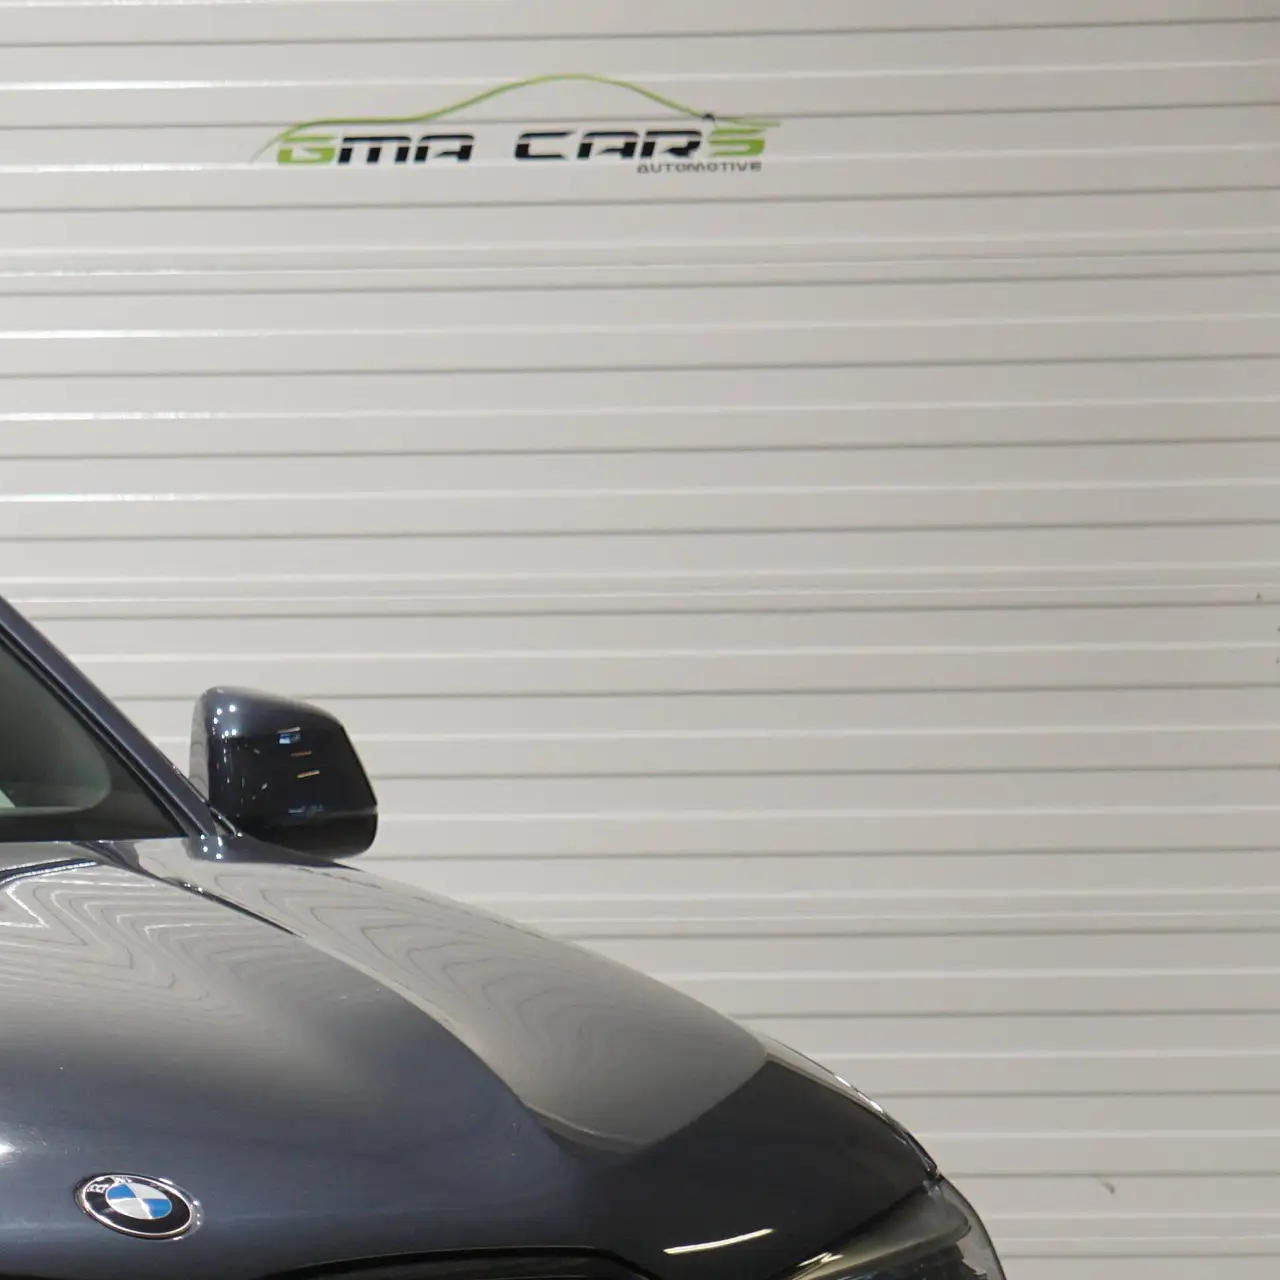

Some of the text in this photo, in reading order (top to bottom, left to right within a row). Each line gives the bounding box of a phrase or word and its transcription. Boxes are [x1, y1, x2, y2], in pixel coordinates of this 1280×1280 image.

[277, 129, 767, 165] GMA CARS
[636, 161, 762, 173] AUTOMOTIVE
